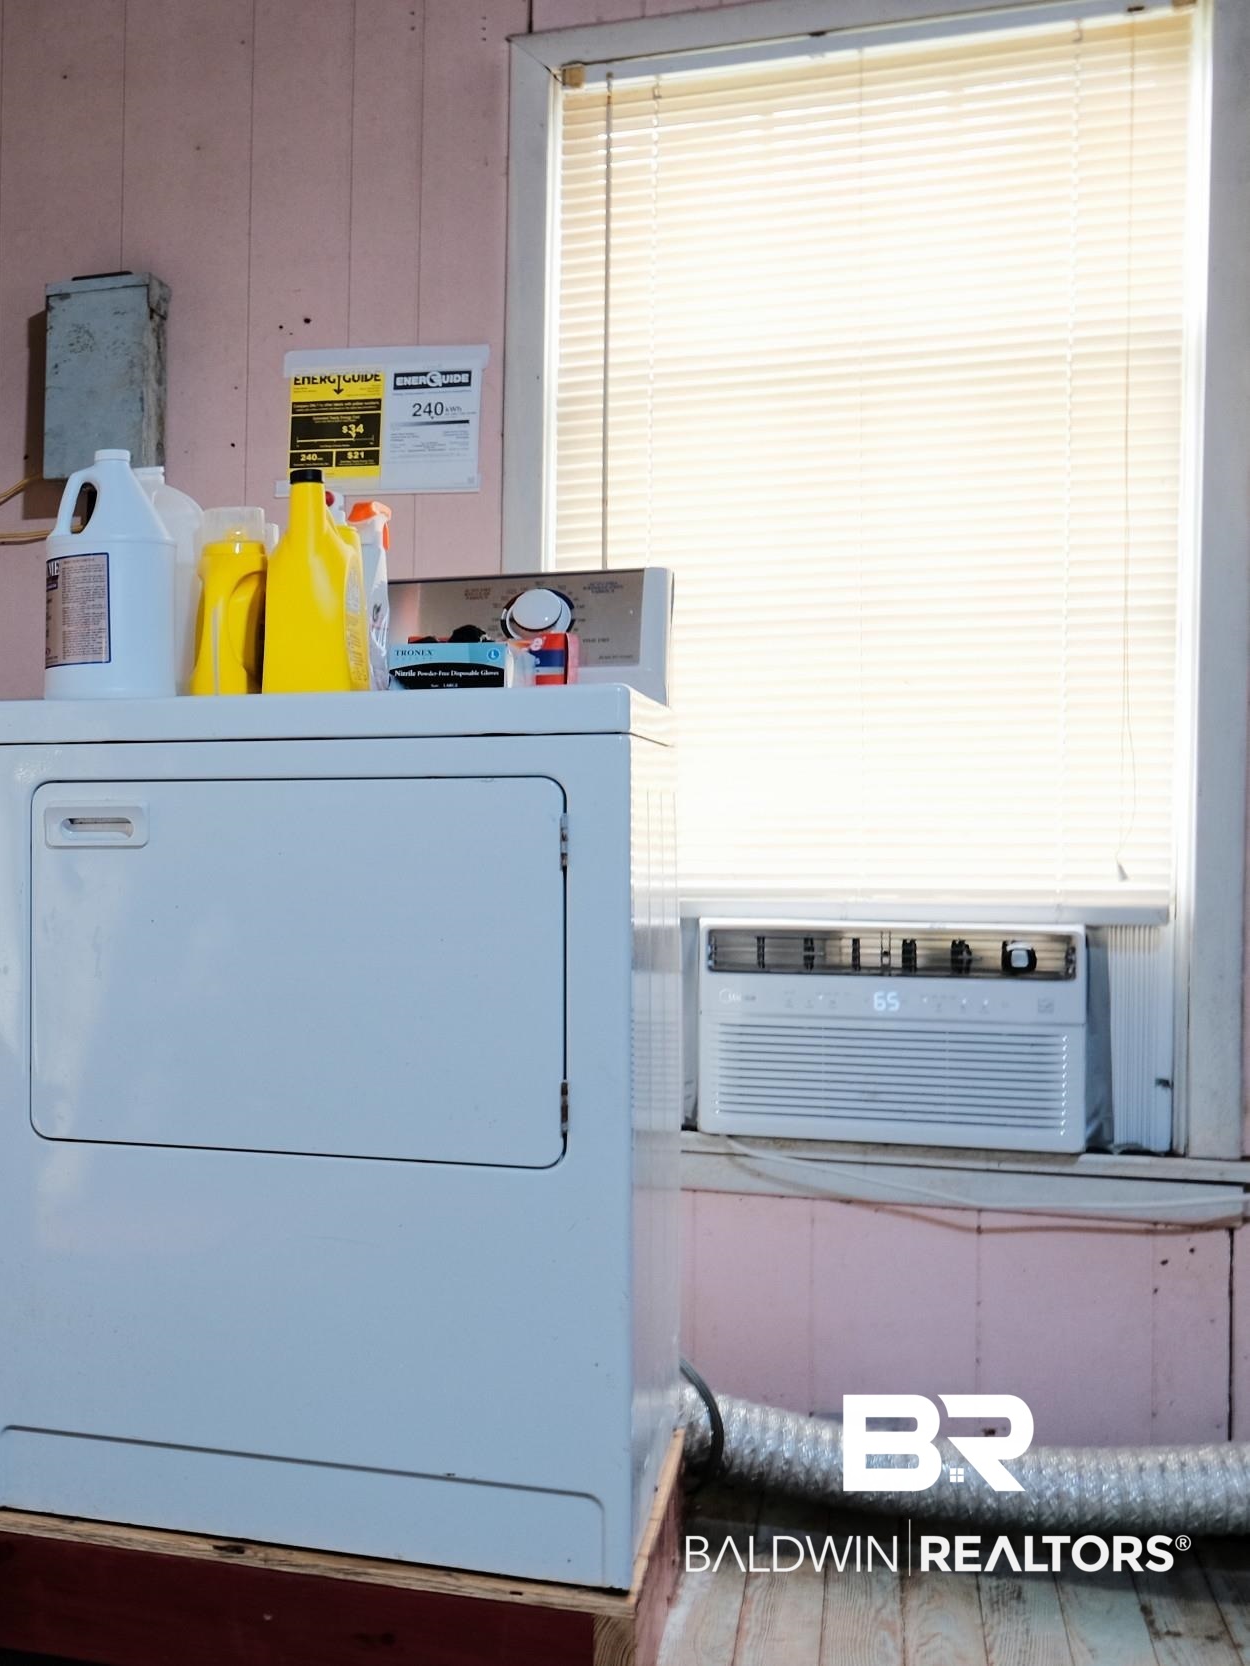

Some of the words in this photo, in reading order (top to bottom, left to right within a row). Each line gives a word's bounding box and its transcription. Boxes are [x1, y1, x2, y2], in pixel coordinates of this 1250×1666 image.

[395, 371, 470, 387] ENERGUIDE
[412, 402, 444, 417] 240
[341, 423, 364, 435] $34
[300, 453, 318, 462] 240
[346, 451, 365, 460] $21
[394, 669, 416, 677] Nitrile
[872, 990, 901, 1012] 65
